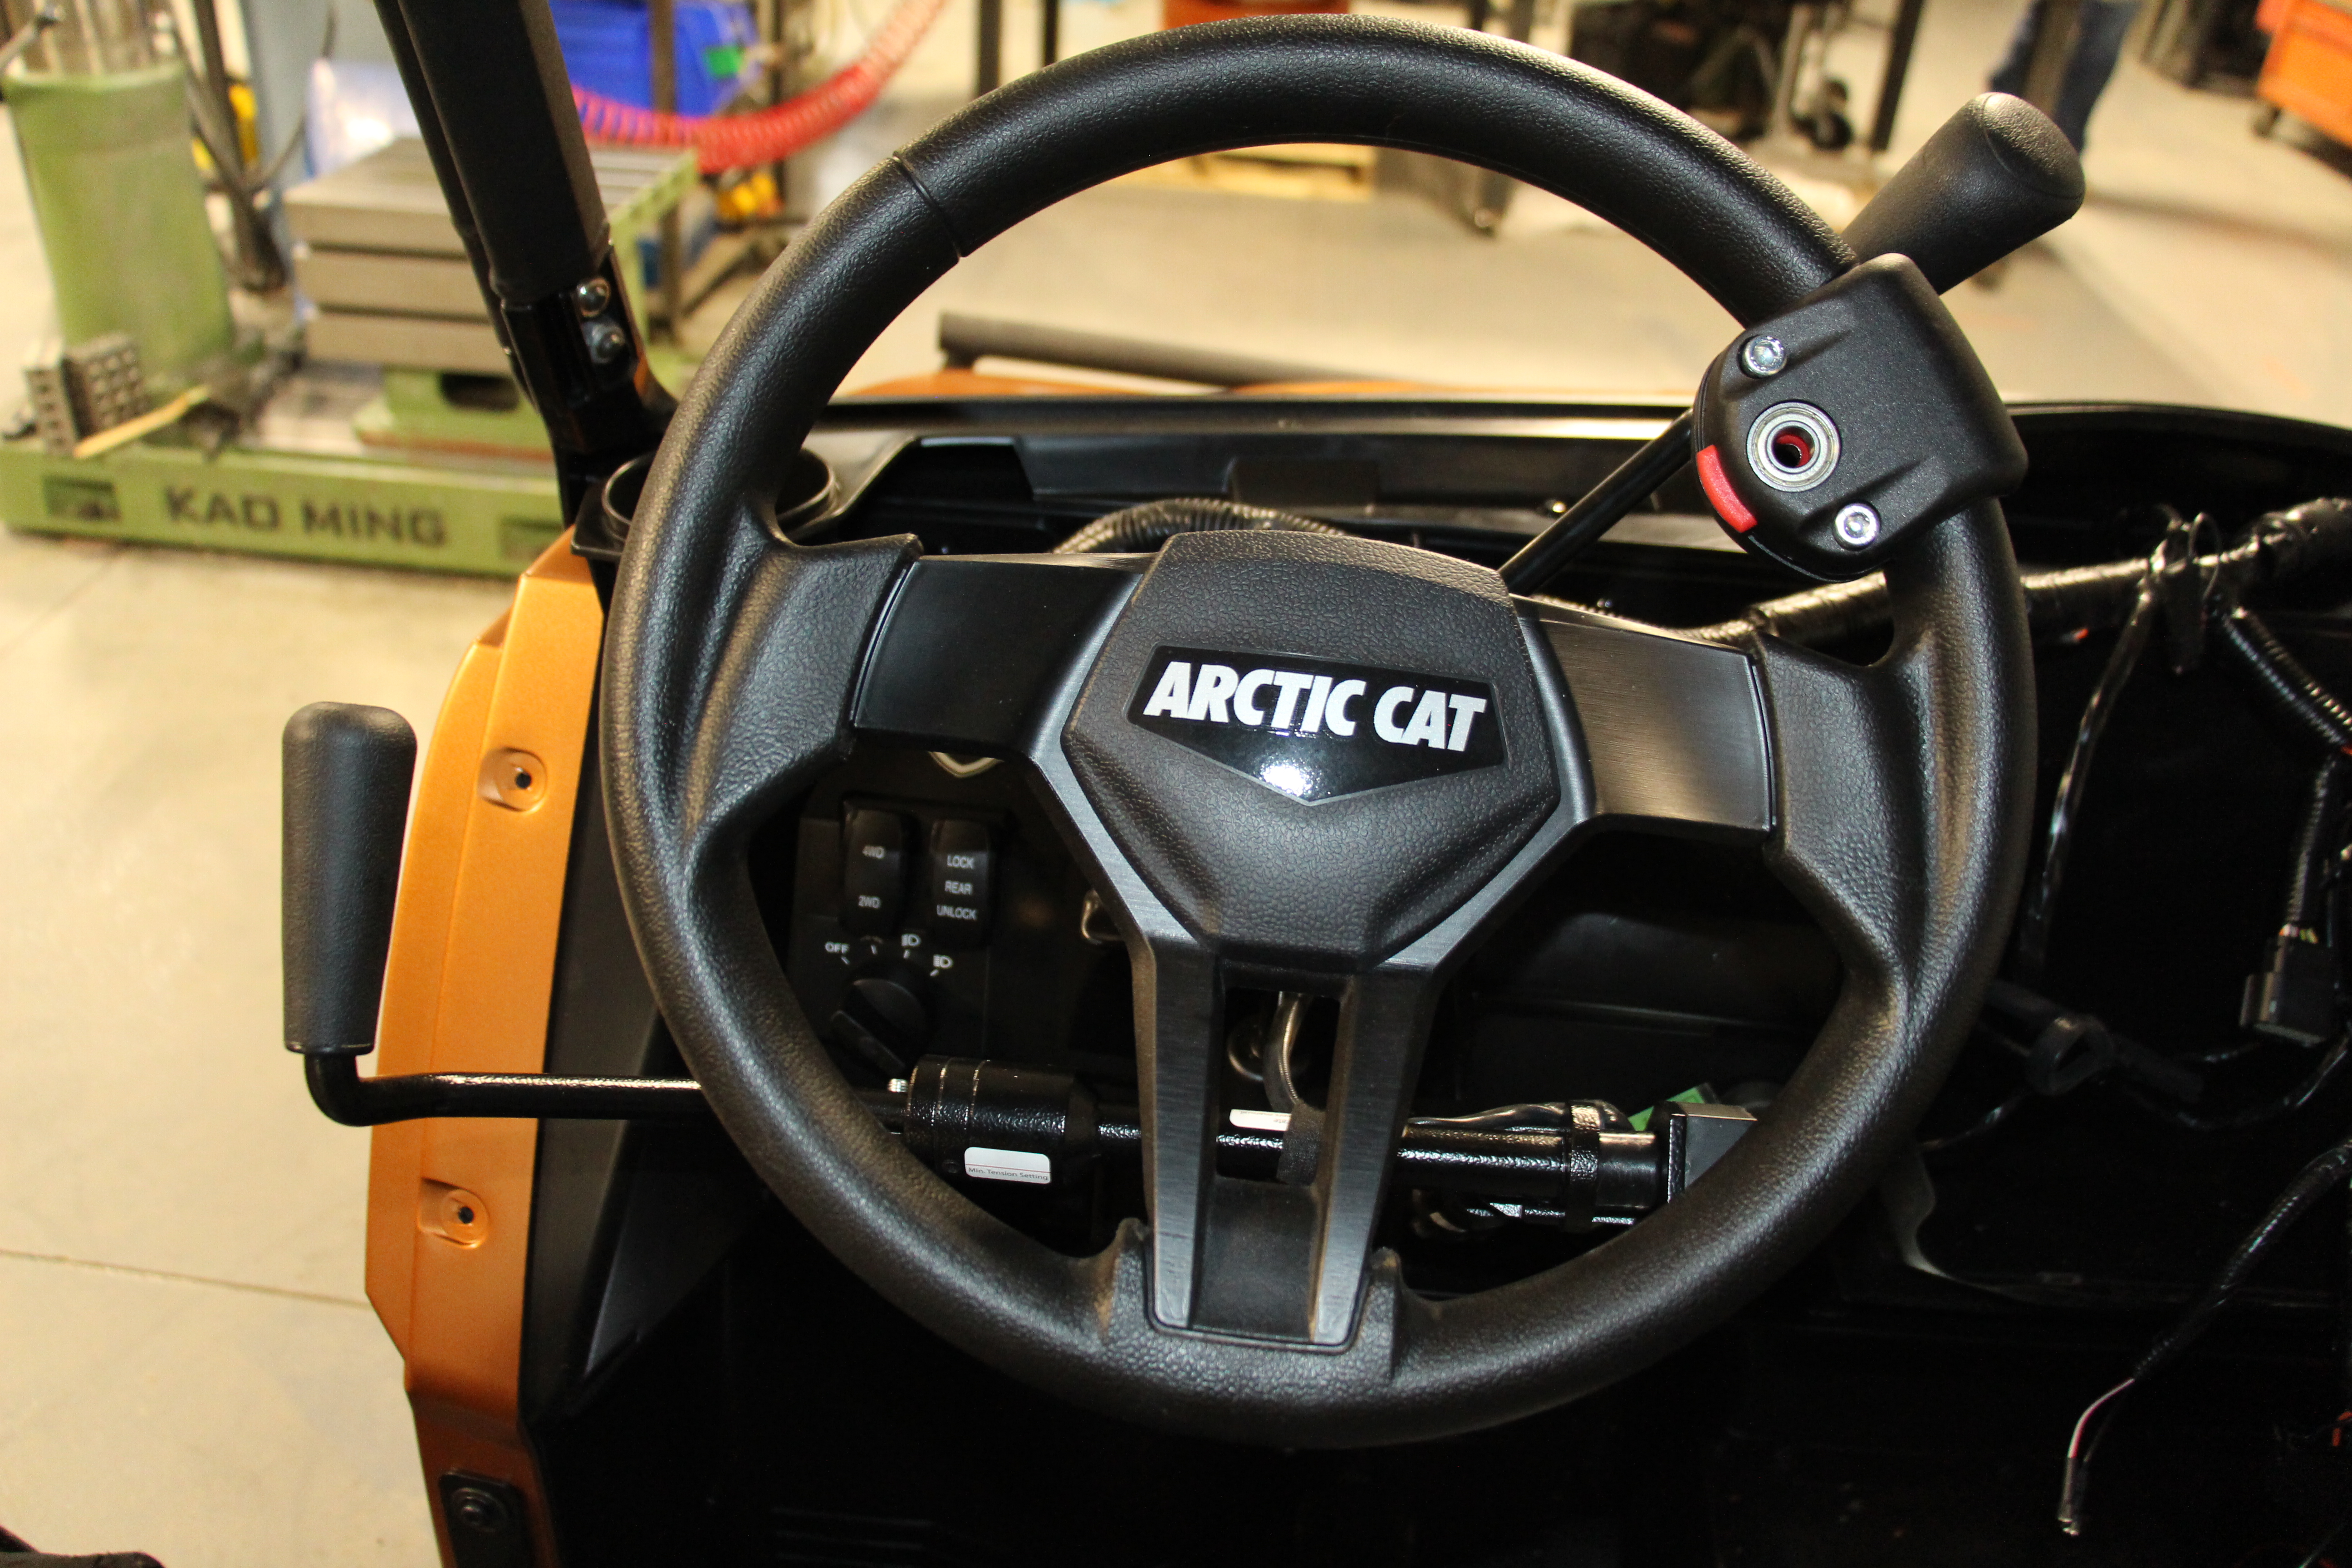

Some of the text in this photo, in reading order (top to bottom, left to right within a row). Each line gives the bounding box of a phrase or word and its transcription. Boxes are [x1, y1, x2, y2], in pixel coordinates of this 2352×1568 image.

[164, 485, 447, 548] KAO MING
[1142, 661, 1487, 751] ARCTIC CAT
[862, 845, 884, 859] 4WD
[947, 854, 974, 869] LOCK
[945, 880, 973, 895] REAR
[858, 895, 881, 908] 2WD
[936, 905, 976, 920] UNLOCK
[825, 941, 849, 953] OFF
[987, 1169, 1017, 1177] Tension
